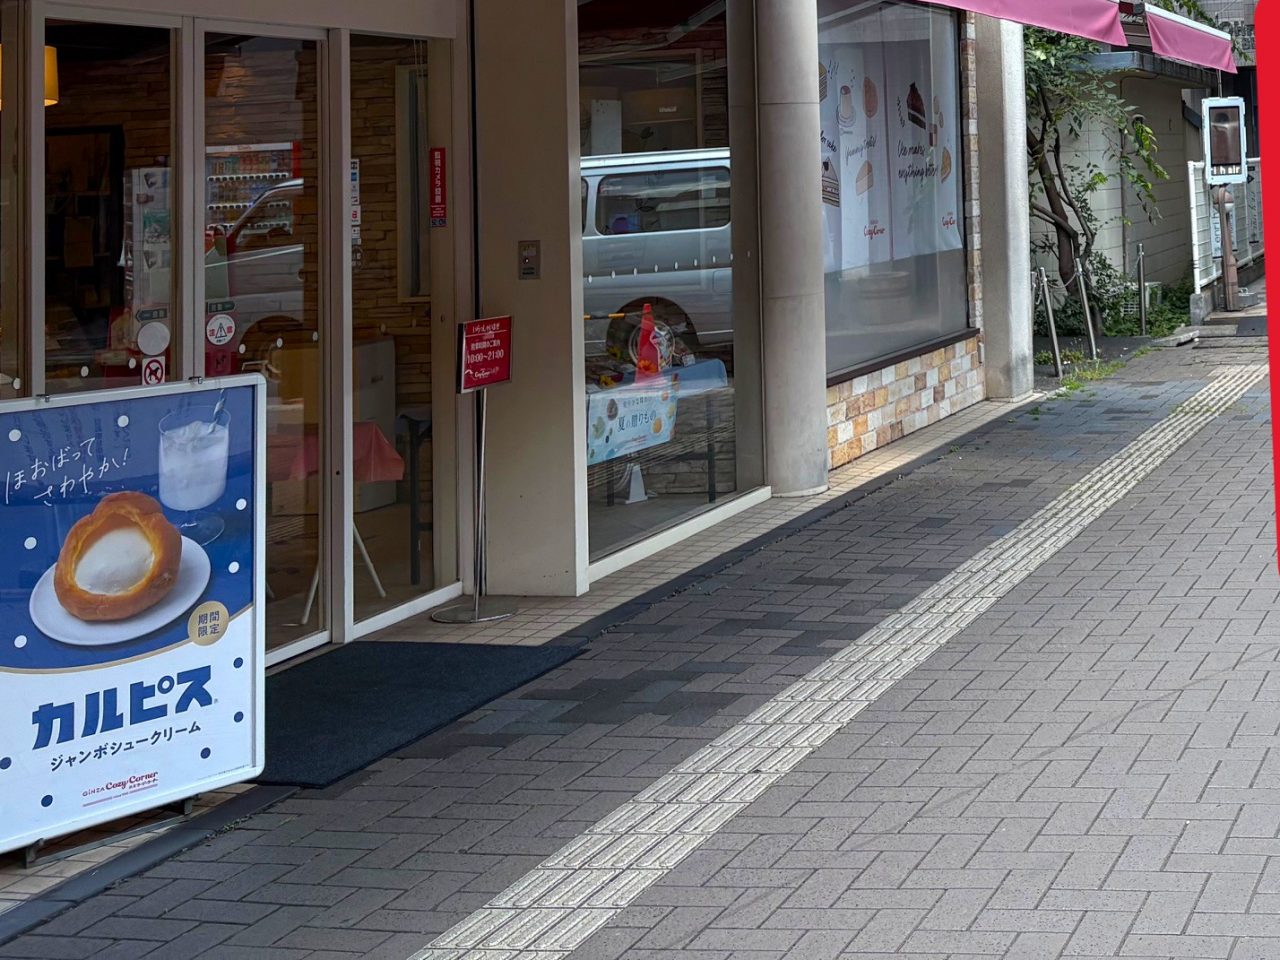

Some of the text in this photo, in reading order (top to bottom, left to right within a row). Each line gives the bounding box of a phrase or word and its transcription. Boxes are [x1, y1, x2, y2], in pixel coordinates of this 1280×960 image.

[5, 437, 96, 505] ほおばって
[32, 664, 213, 752] カルピス
[50, 721, 202, 772] ジャンボシュークリーム
